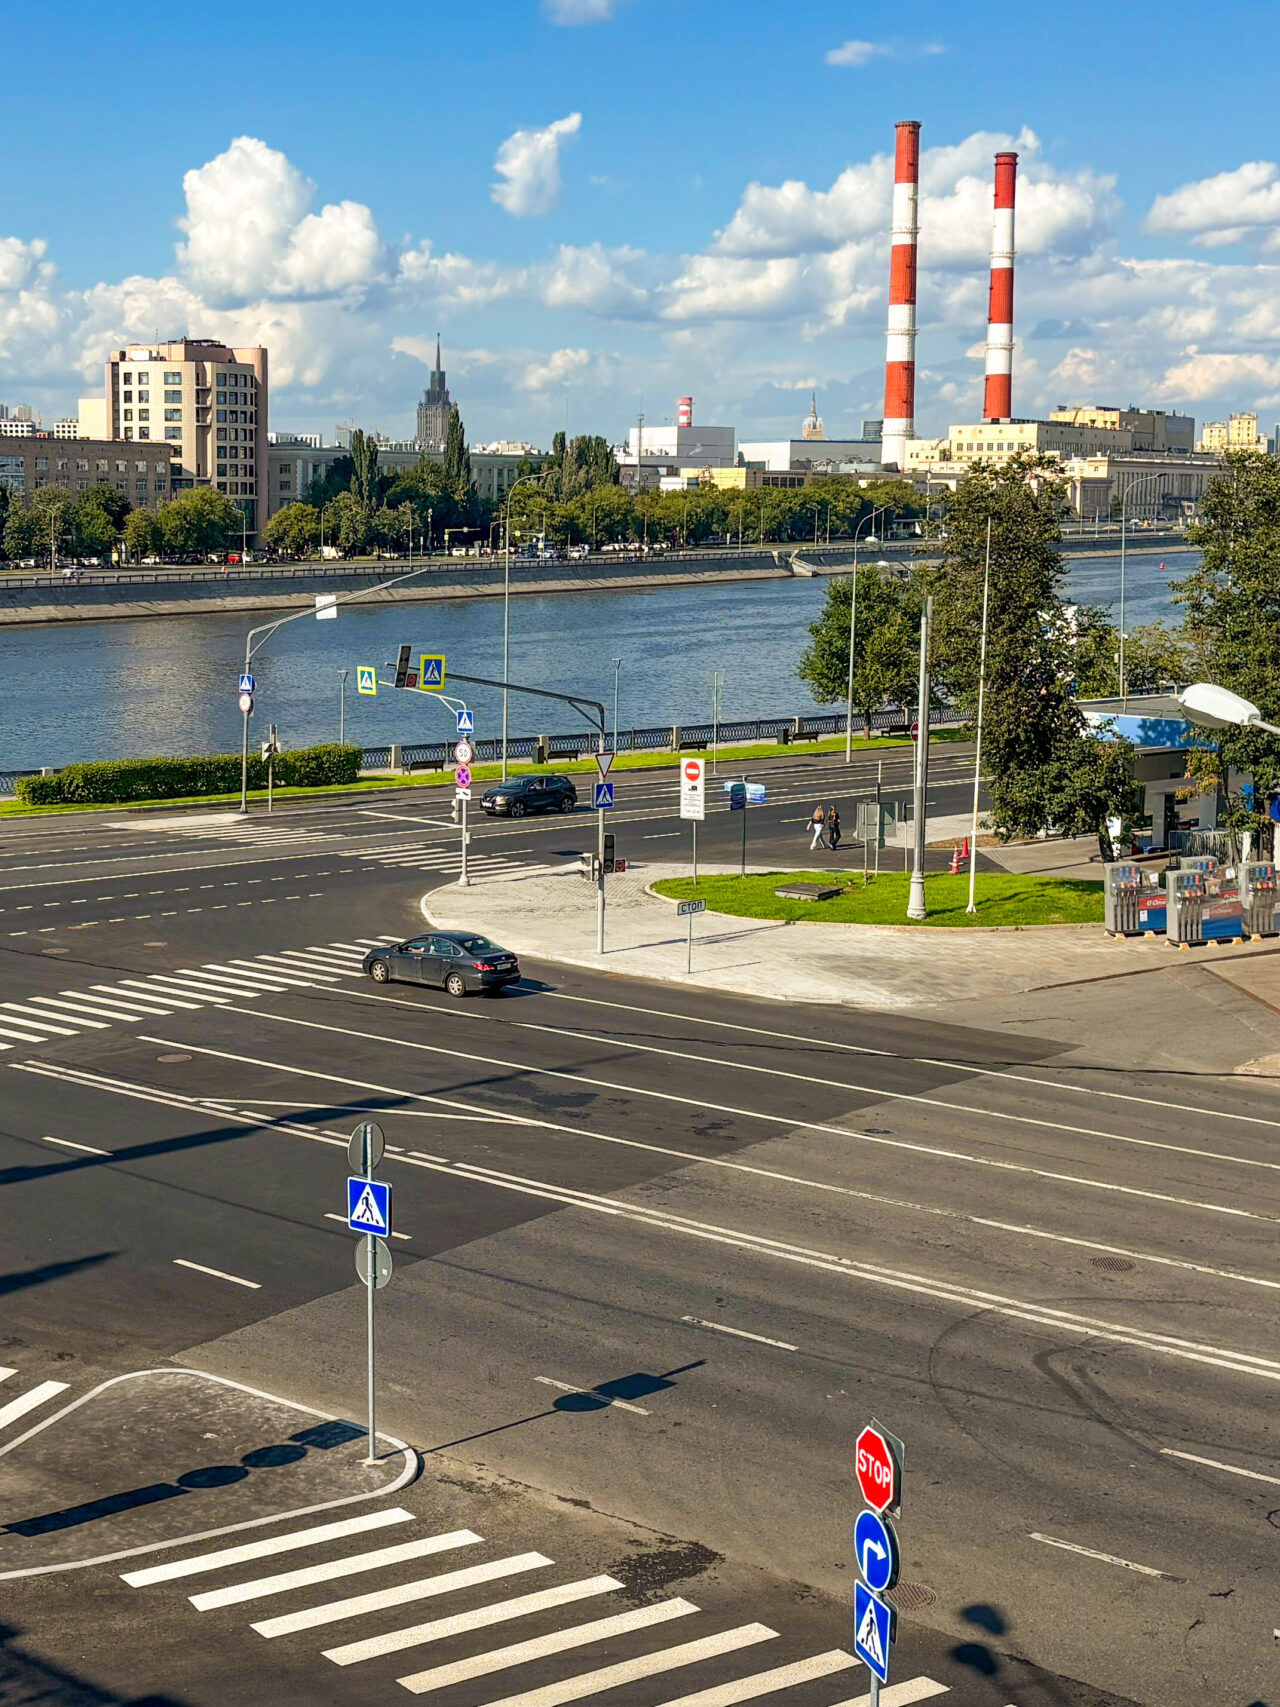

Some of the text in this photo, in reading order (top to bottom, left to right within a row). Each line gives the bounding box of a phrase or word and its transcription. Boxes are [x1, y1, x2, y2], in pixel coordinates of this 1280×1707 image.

[459, 748, 468, 758] 50
[681, 901, 703, 913] СТОП
[858, 1448, 891, 1489] STOP
